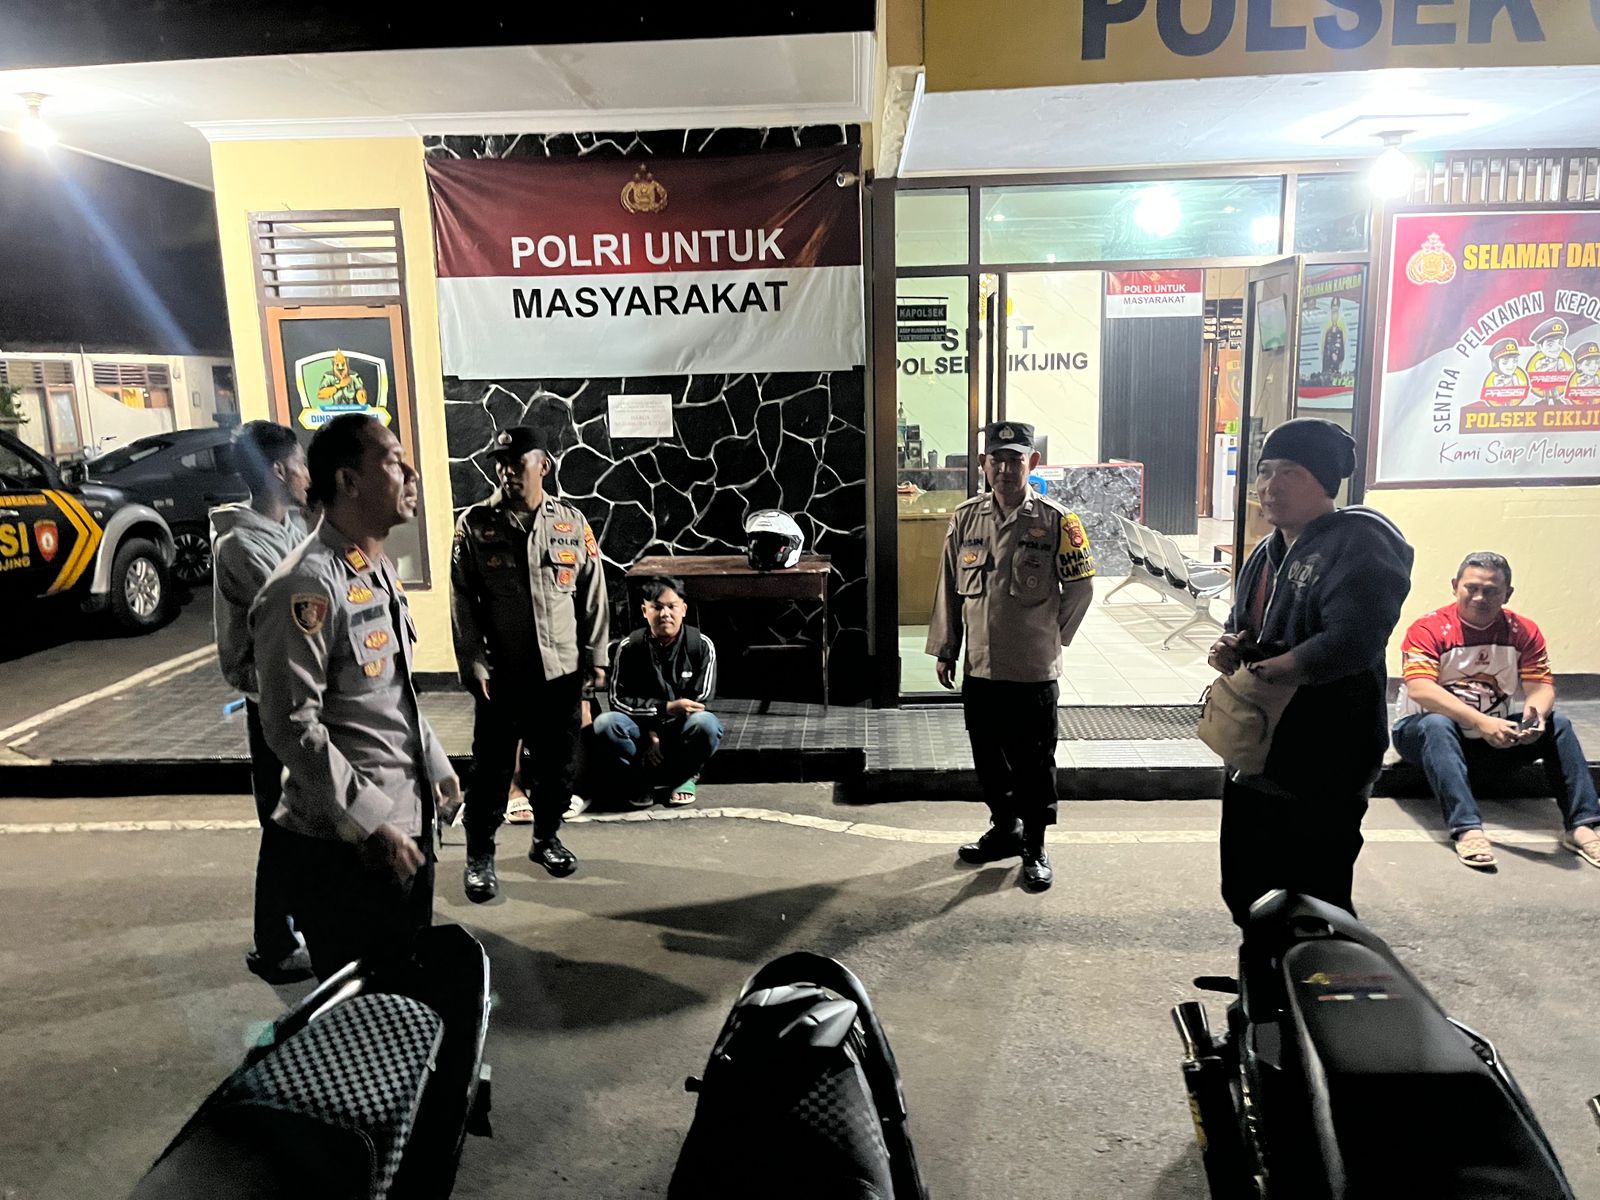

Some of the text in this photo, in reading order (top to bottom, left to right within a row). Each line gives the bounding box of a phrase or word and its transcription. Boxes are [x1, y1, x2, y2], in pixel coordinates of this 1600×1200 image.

[511, 228, 786, 268] POLRI UNTUK
[1463, 242, 1563, 271] SELAMAT
[1123, 283, 1186, 294] POLRI UNTUK
[512, 281, 788, 318] MASYARAKAT
[1123, 295, 1186, 305] MASYARAKAT
[899, 308, 944, 318] KAPOLSEK
[1008, 352, 1088, 372] IKIJING
[1433, 368, 1461, 433] SENTRA
[1456, 292, 1543, 358] PELAYANAN
[1465, 411, 1538, 428] POLSEK
[1439, 438, 1598, 464] Kami Siap Melayani
[550, 538, 580, 547] POLRI
